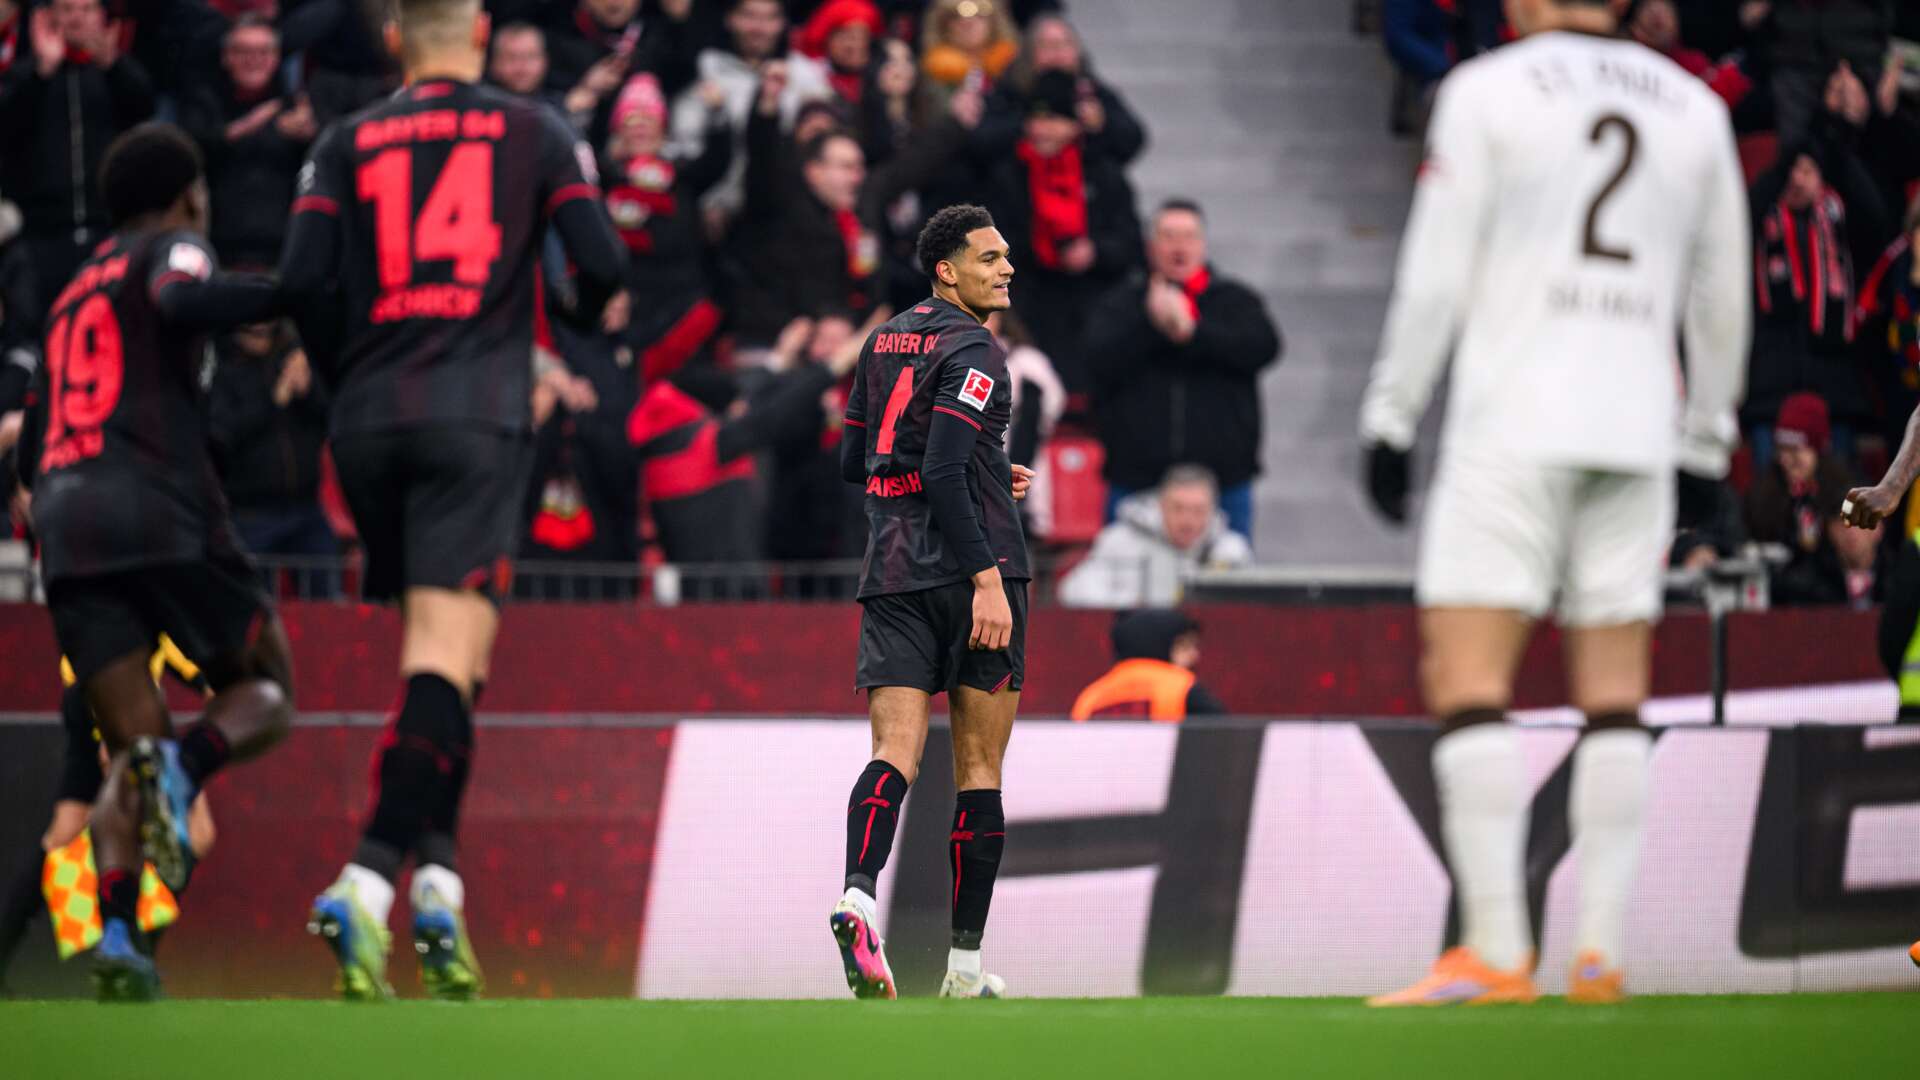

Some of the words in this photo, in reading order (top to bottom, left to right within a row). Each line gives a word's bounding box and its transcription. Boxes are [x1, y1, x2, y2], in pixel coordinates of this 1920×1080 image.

[357, 142, 503, 289] 14
[1581, 113, 1638, 262] 2
[46, 293, 124, 446] 19
[873, 332, 921, 354] BAYER
